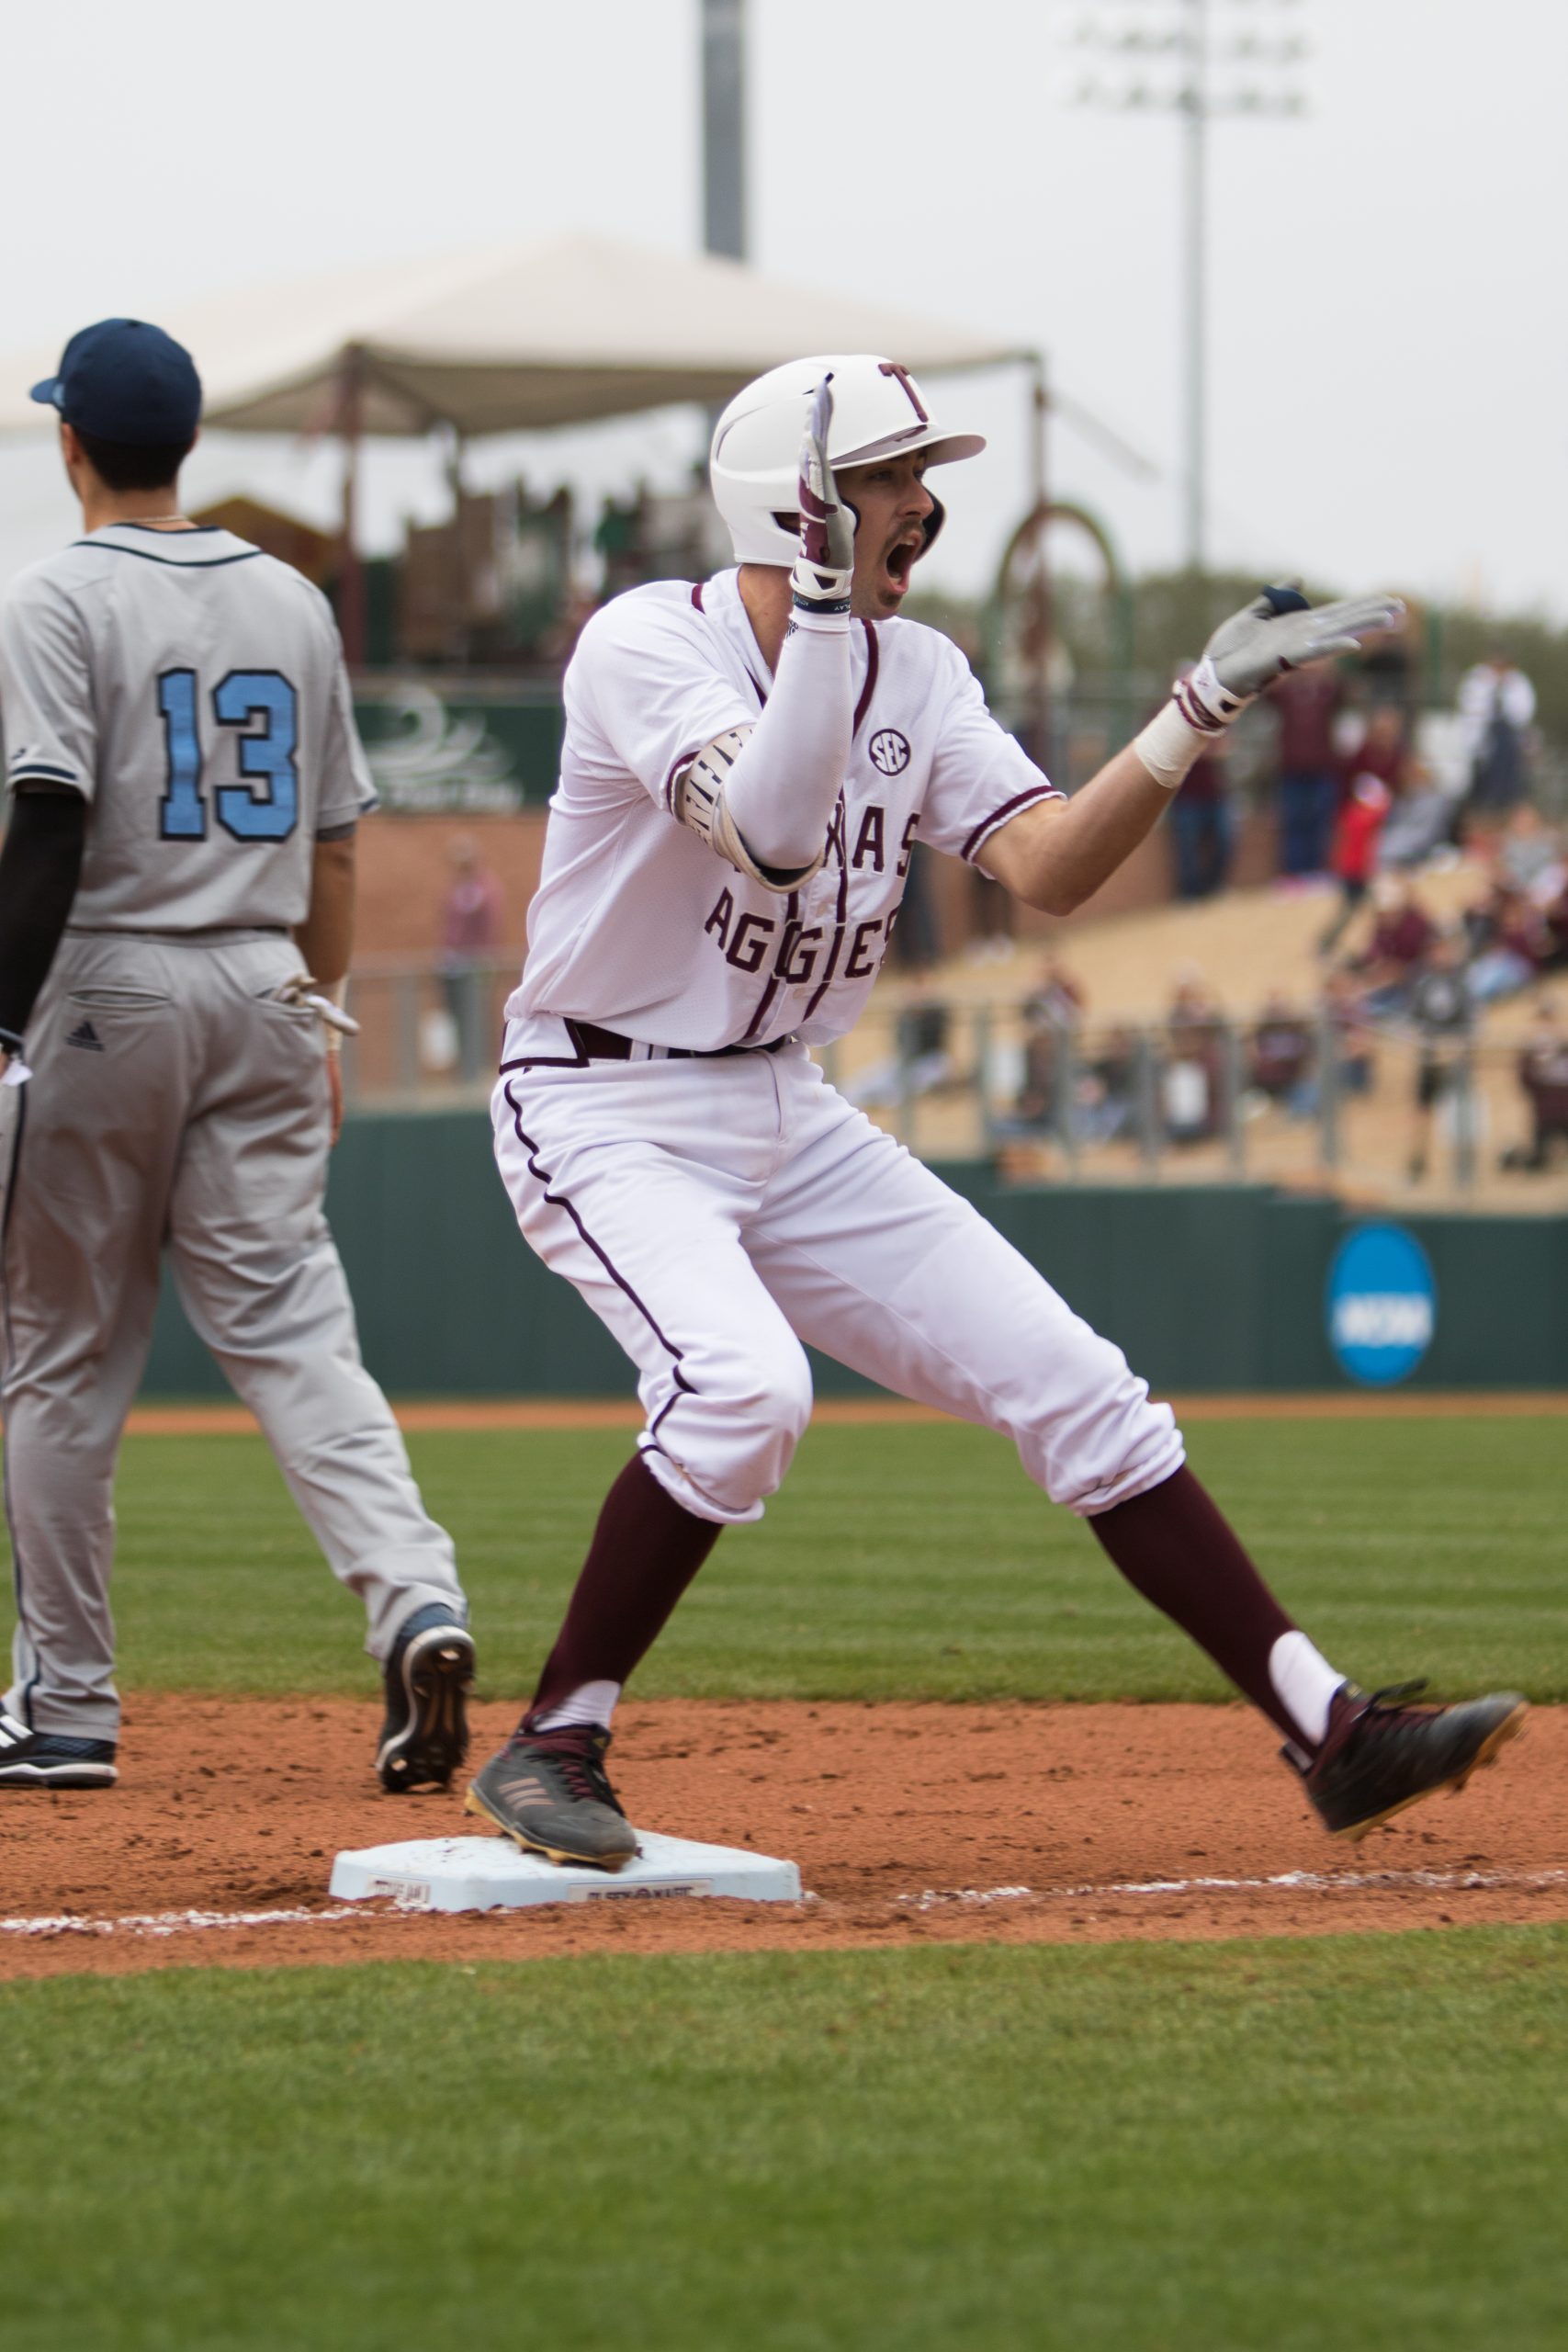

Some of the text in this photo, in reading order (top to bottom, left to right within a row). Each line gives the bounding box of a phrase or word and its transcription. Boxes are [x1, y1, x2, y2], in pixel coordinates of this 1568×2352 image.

[878, 363, 929, 423] T
[157, 667, 299, 842] 13
[870, 731, 908, 774] SEC
[825, 801, 921, 877] XAS
